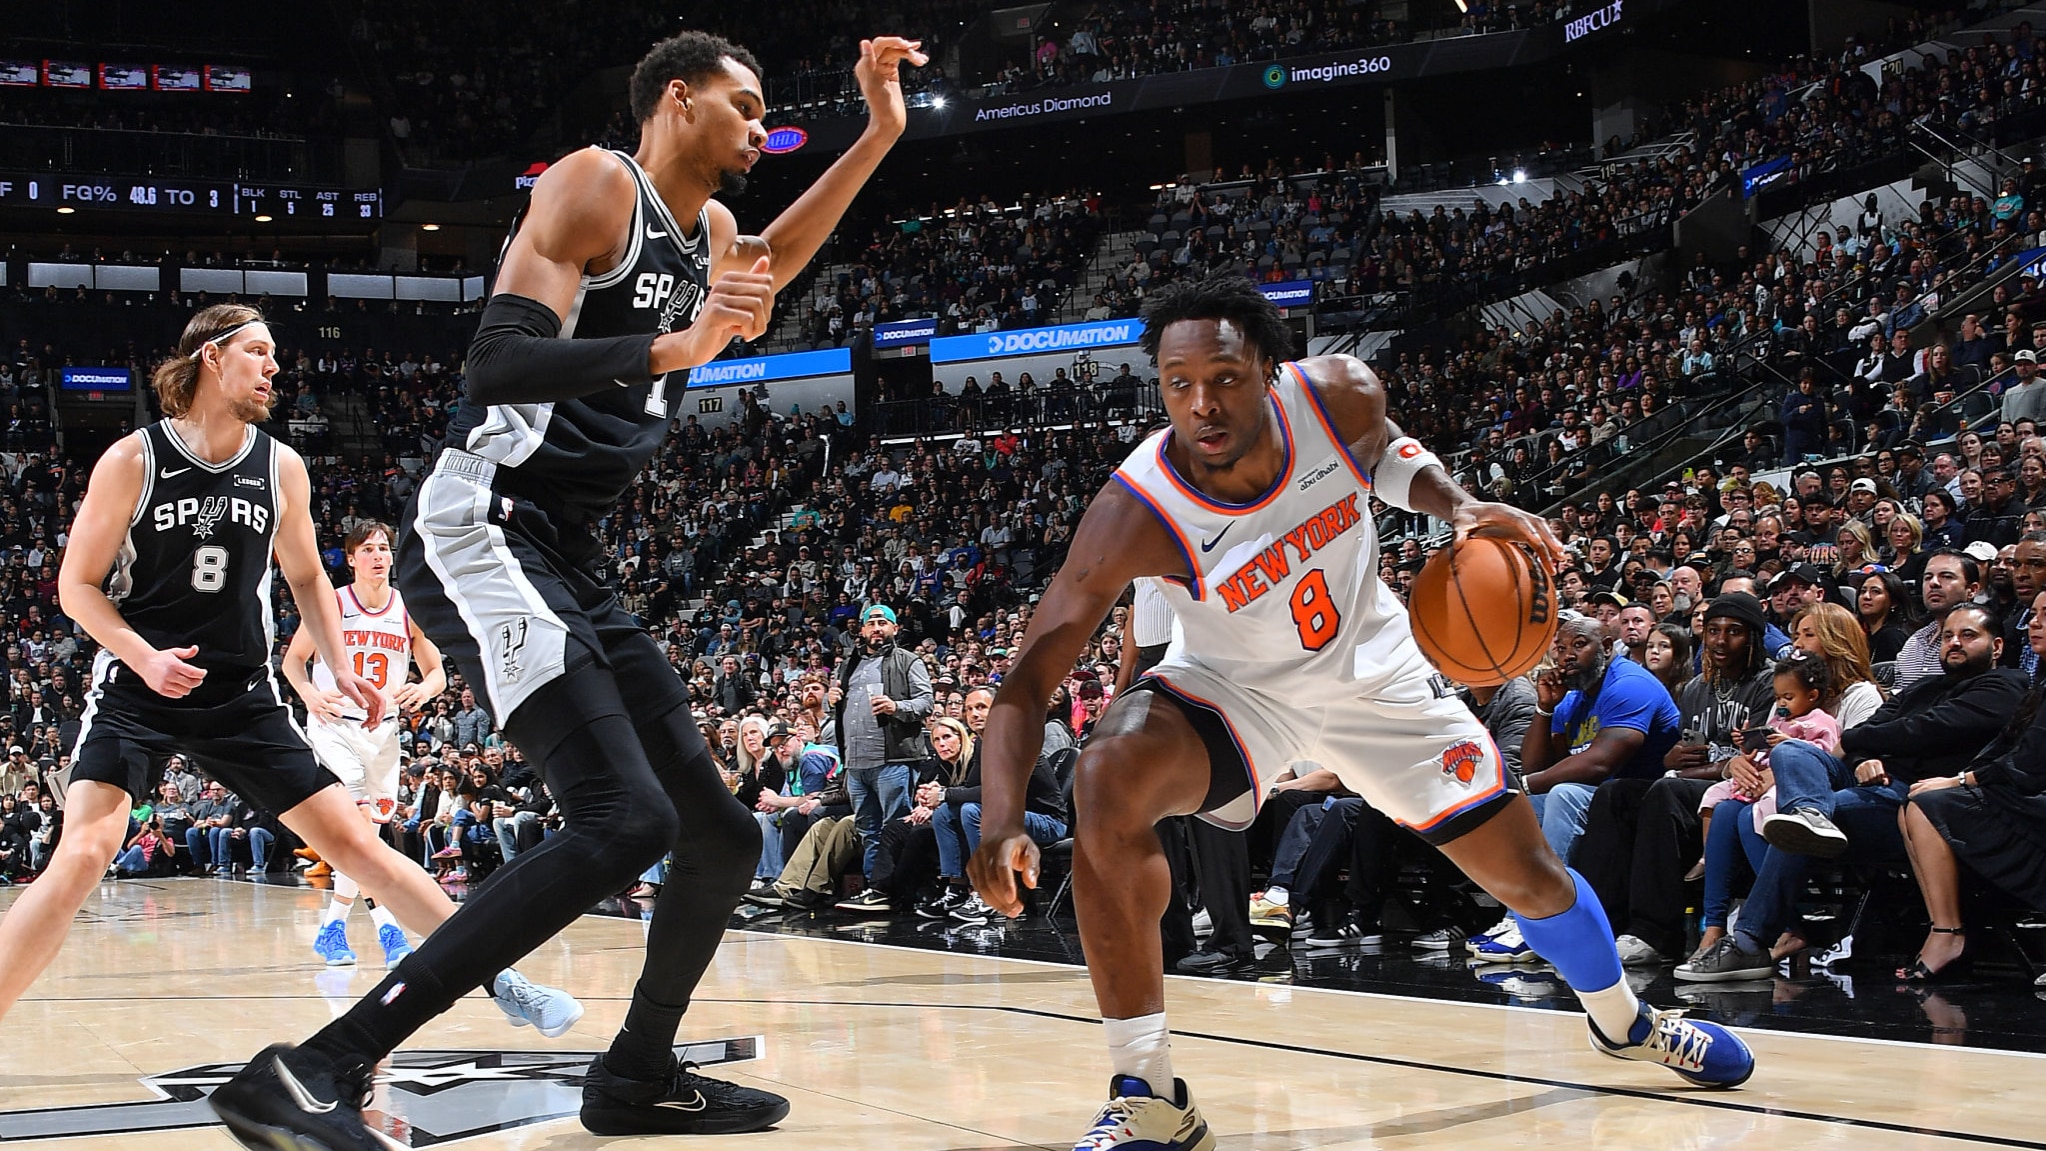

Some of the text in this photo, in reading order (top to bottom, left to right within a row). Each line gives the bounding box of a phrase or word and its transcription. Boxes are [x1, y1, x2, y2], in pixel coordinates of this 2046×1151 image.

[1564, 5, 1611, 43] RBFCU
[1291, 56, 1391, 82] imagine360
[975, 91, 1112, 121] Americus Diamond
[769, 133, 799, 147] AHIA
[515, 175, 539, 189] Pizz
[1600, 162, 1616, 179] 119
[29, 181, 39, 200] 0
[62, 184, 117, 202] FG%
[130, 186, 157, 205] 48.6
[164, 189, 195, 205] TO
[209, 190, 218, 207] 3
[242, 188, 377, 202] BLK STL AST REB
[251, 200, 256, 213] 1
[287, 201, 294, 214] 5
[322, 203, 334, 216] 25
[318, 326, 340, 339] 116
[1003, 325, 1130, 353] DOCUMATION
[690, 362, 766, 384] UMATION
[700, 398, 721, 412] 117
[1216, 492, 1361, 613] NEW YORK
[190, 545, 230, 594] 8
[1289, 568, 1341, 652] 8
[371, 631, 406, 653] YORK
[353, 651, 388, 690] 13
